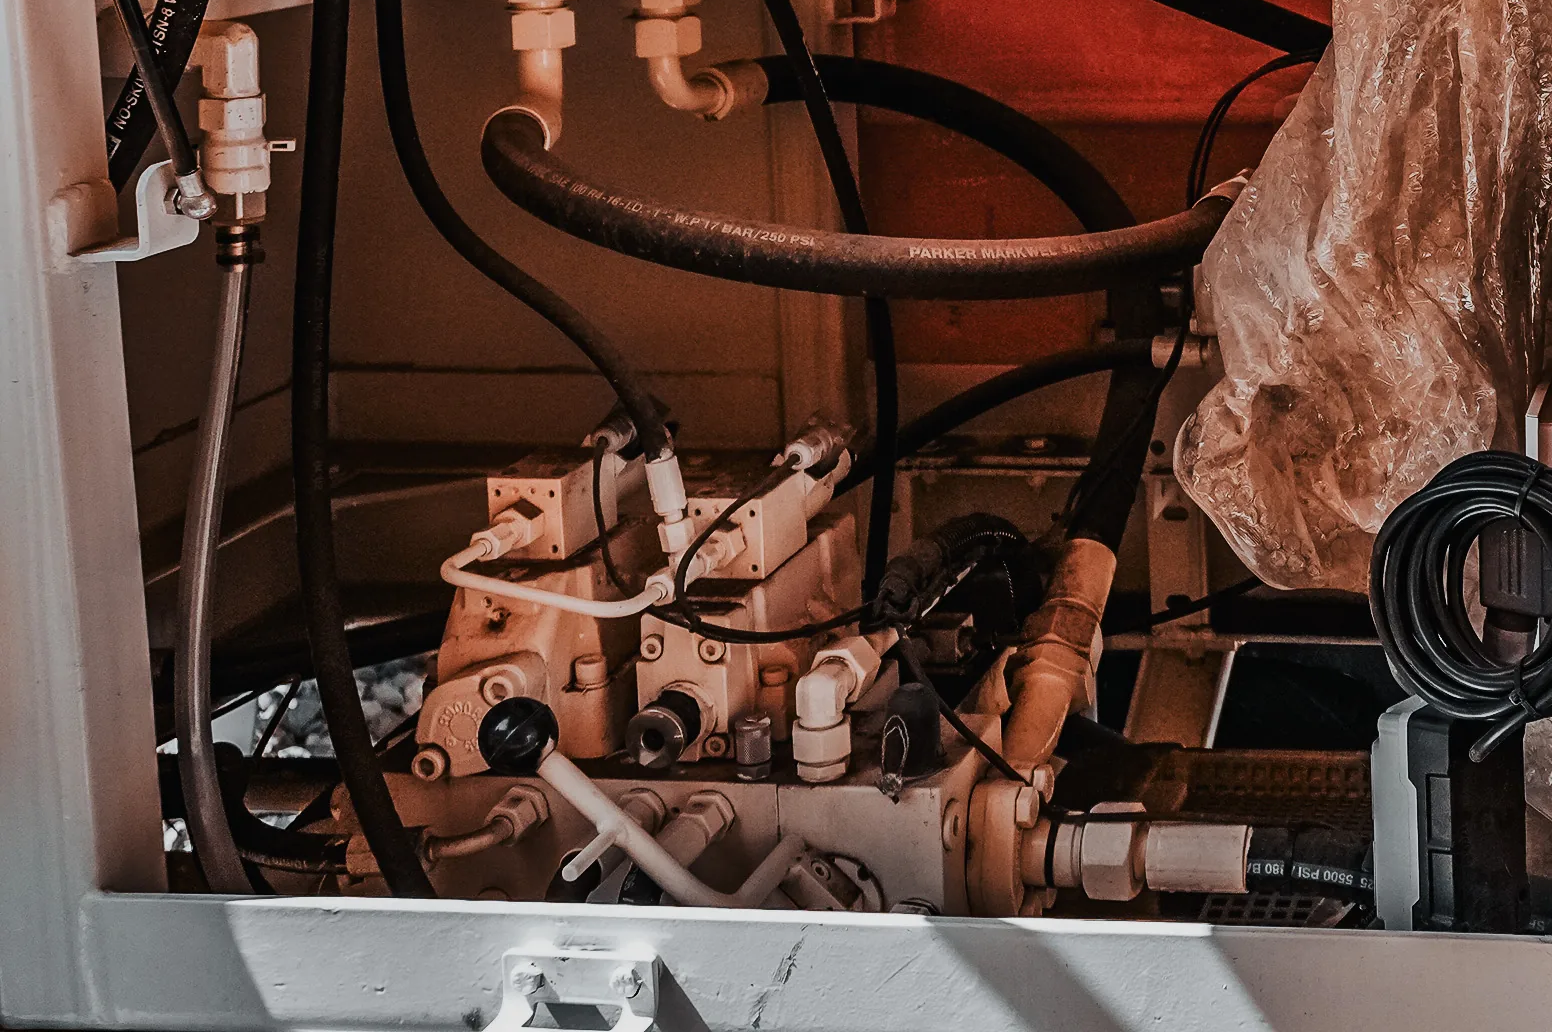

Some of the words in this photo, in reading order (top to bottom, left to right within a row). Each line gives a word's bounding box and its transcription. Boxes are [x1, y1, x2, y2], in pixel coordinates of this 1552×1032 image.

[114, 77, 146, 130] NO-SKI
[721, 224, 787, 243] BAR/250
[790, 235, 815, 246] PSI
[908, 246, 977, 259] PARKER
[980, 246, 1058, 259] MARKWEL
[1298, 867, 1320, 880] PSI
[1323, 870, 1353, 886] 5500
